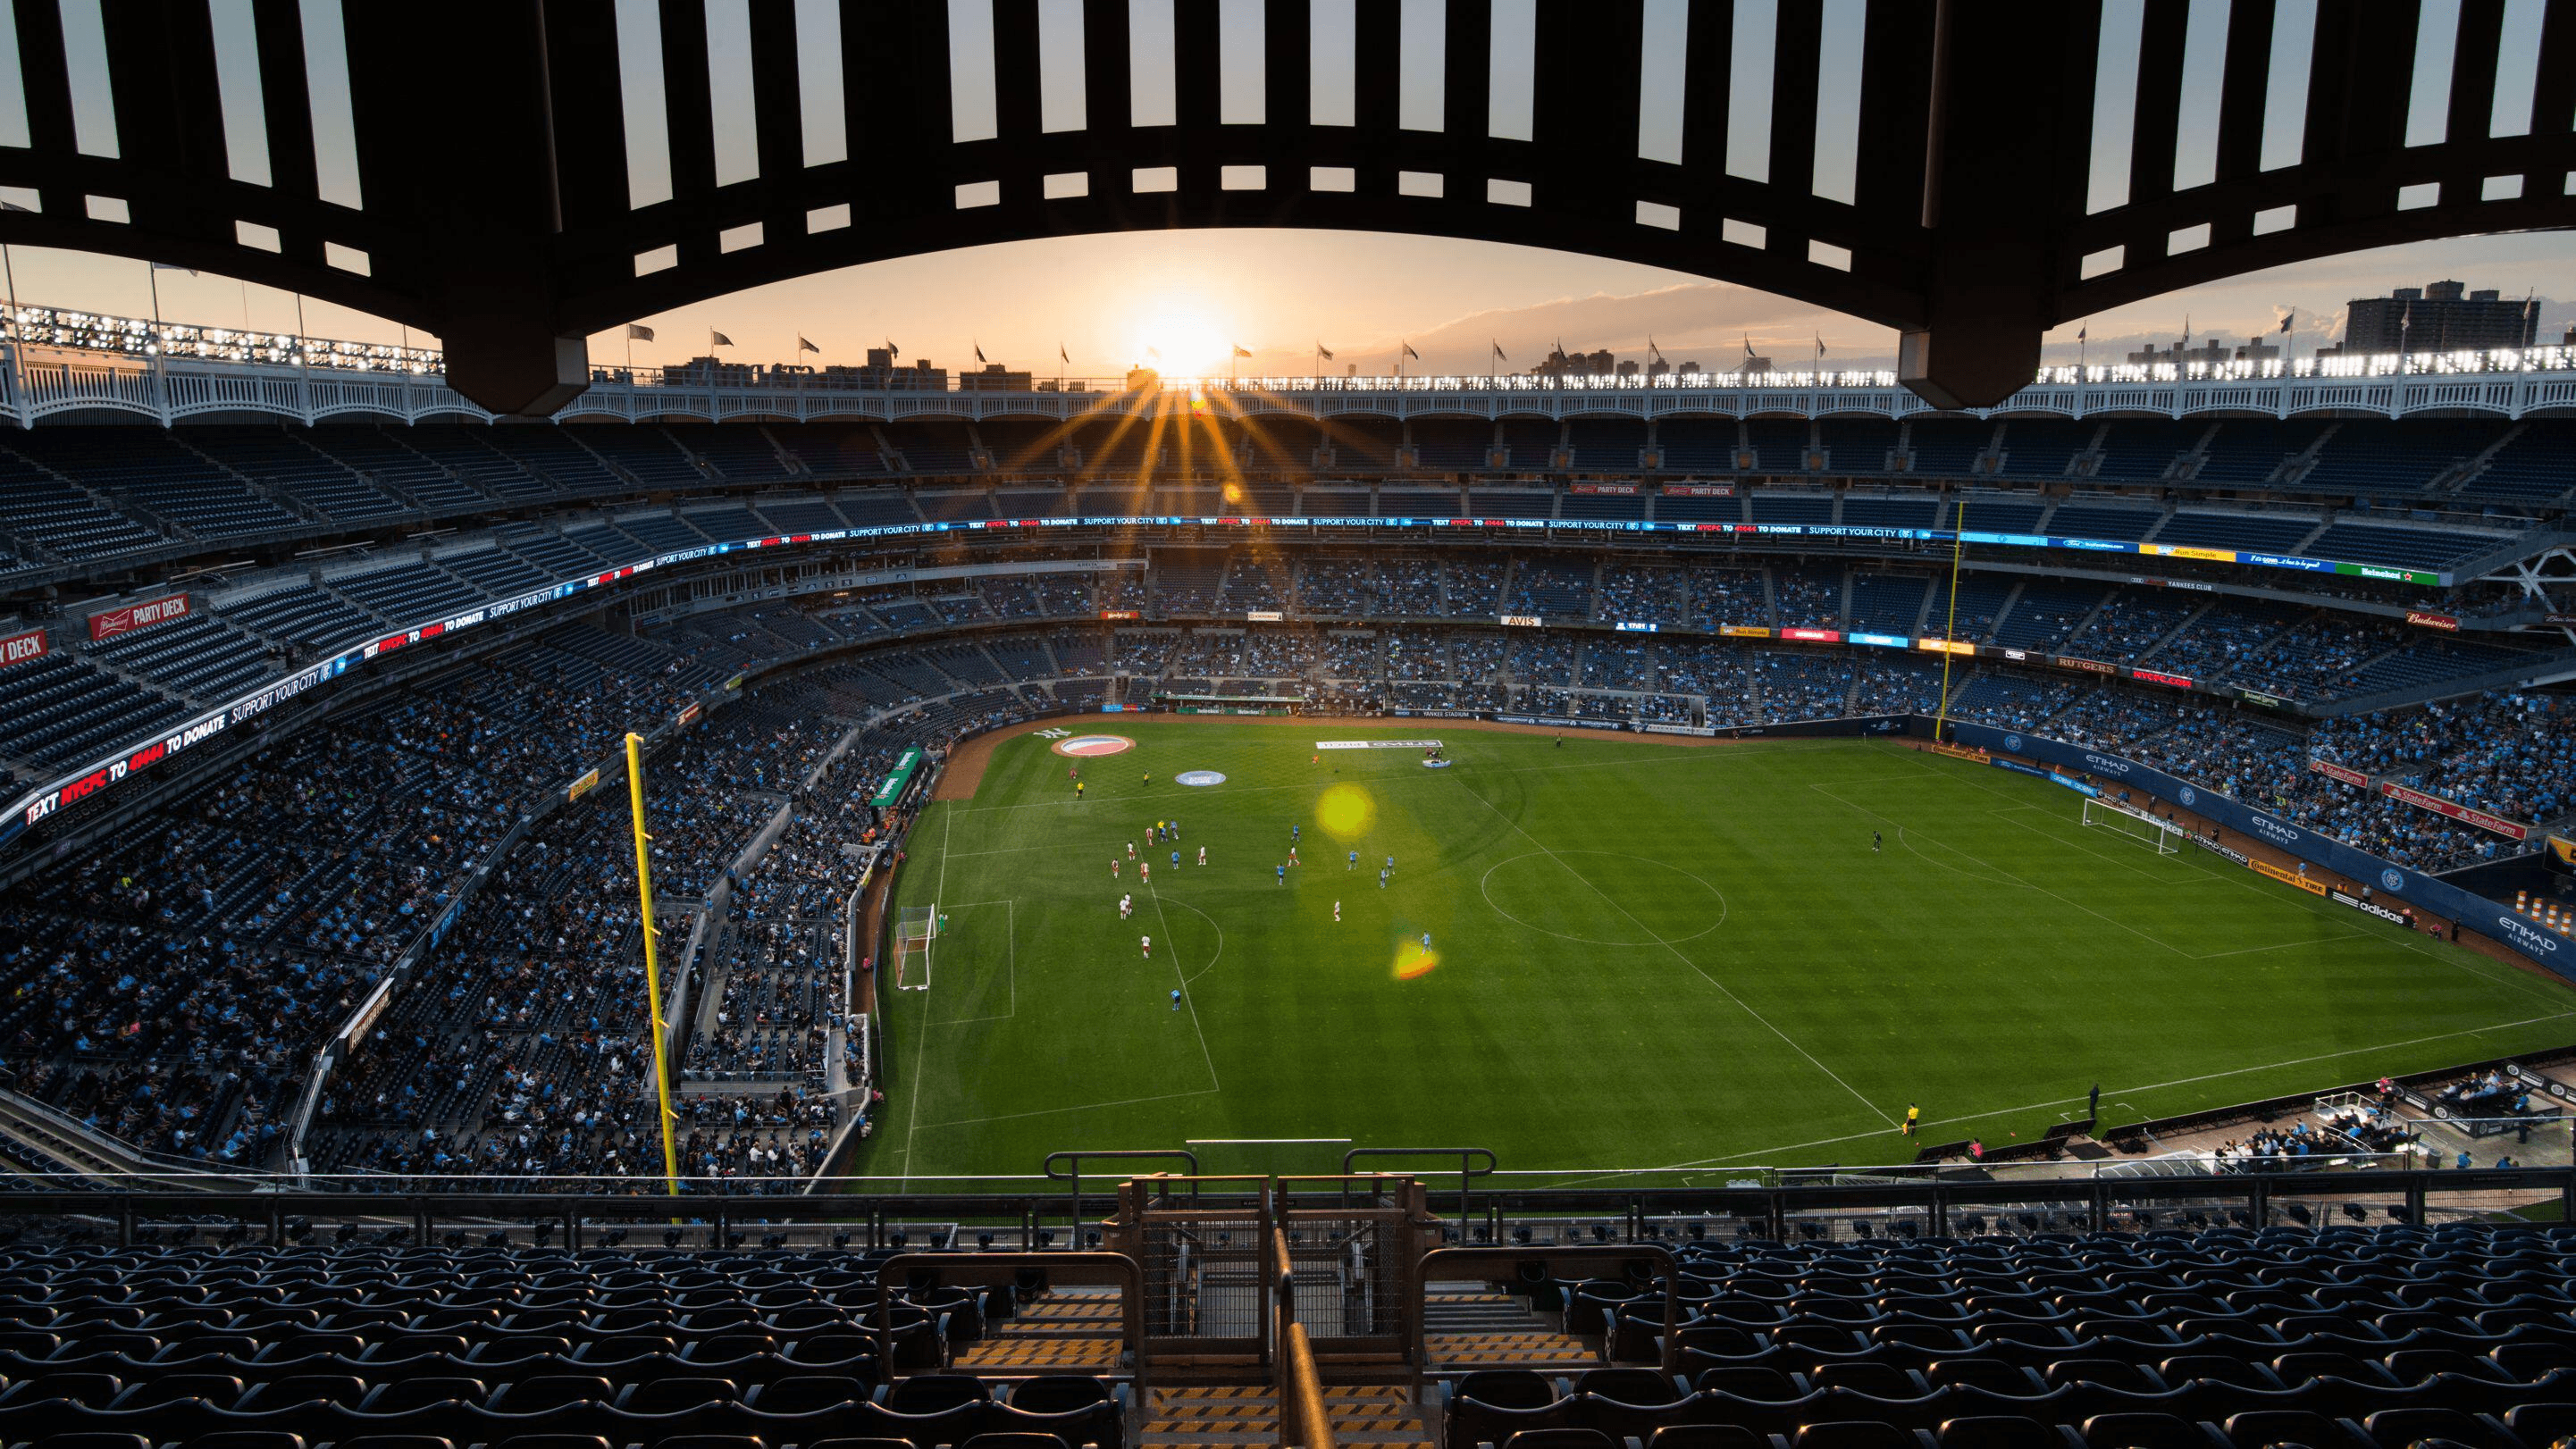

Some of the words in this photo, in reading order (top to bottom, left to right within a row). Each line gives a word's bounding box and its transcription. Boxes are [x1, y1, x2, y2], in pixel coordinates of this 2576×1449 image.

[1084, 517, 1115, 525] SUPPORT
[1346, 518, 1366, 526] YOUR
[1366, 518, 1384, 526] CITY
[1548, 521, 1582, 529] SUPPORT
[1583, 521, 1606, 529] YOUR
[1606, 522, 1624, 530] CITY
[850, 527, 883, 538] SUPPORT
[883, 526, 903, 535] YOUR
[903, 525, 920, 533] CITY
[1809, 527, 1846, 535] SUPPORT
[1849, 528, 1874, 536] YOUR
[1875, 529, 1896, 537] CITY
[747, 540, 761, 549] TEXT
[820, 532, 845, 540] DONATE
[656, 553, 677, 566] SUPPORT
[678, 551, 694, 561] YOUR
[694, 549, 707, 557] CITY
[2361, 567, 2402, 580] Heineken
[2168, 581, 2195, 590] YANKEES
[133, 604, 161, 625] PARTY
[163, 598, 185, 617] DECK
[490, 600, 519, 618] SUPPORT
[520, 595, 537, 608] YOUR
[538, 590, 553, 603] CITY
[1507, 616, 1534, 626] AVIS
[2405, 612, 2456, 630] Budweiser
[364, 643, 379, 659] TEXT
[409, 632, 420, 643] TO
[444, 622, 455, 632] TO
[456, 611, 483, 628] DONATE
[7, 635, 41, 661] DECK
[2059, 657, 2114, 674] RUTGERS
[231, 691, 275, 724] SUPPORT
[275, 679, 299, 704] YOUR
[299, 670, 320, 691] CITY
[1933, 746, 1968, 758] Continental
[27, 792, 60, 825] TEXT
[61, 769, 107, 806] NYCFC
[110, 760, 127, 782] TO
[166, 735, 182, 754] TO
[183, 715, 226, 747] DONATE
[2085, 754, 2129, 773] ETIHAD
[2093, 765, 2121, 777] AIRWAYS
[2252, 817, 2298, 840] ETIHAD
[2259, 828, 2289, 844] AIRWAYS
[2194, 834, 2219, 850] ETIHAD
[2221, 848, 2248, 863] ETIHAD
[2251, 860, 2296, 884] Continental
[2304, 883, 2324, 893] TIRE
[2360, 901, 2404, 924] adidas
[2498, 917, 2557, 951] ETIHAD
[2507, 933, 2545, 956] AIRWAYS
